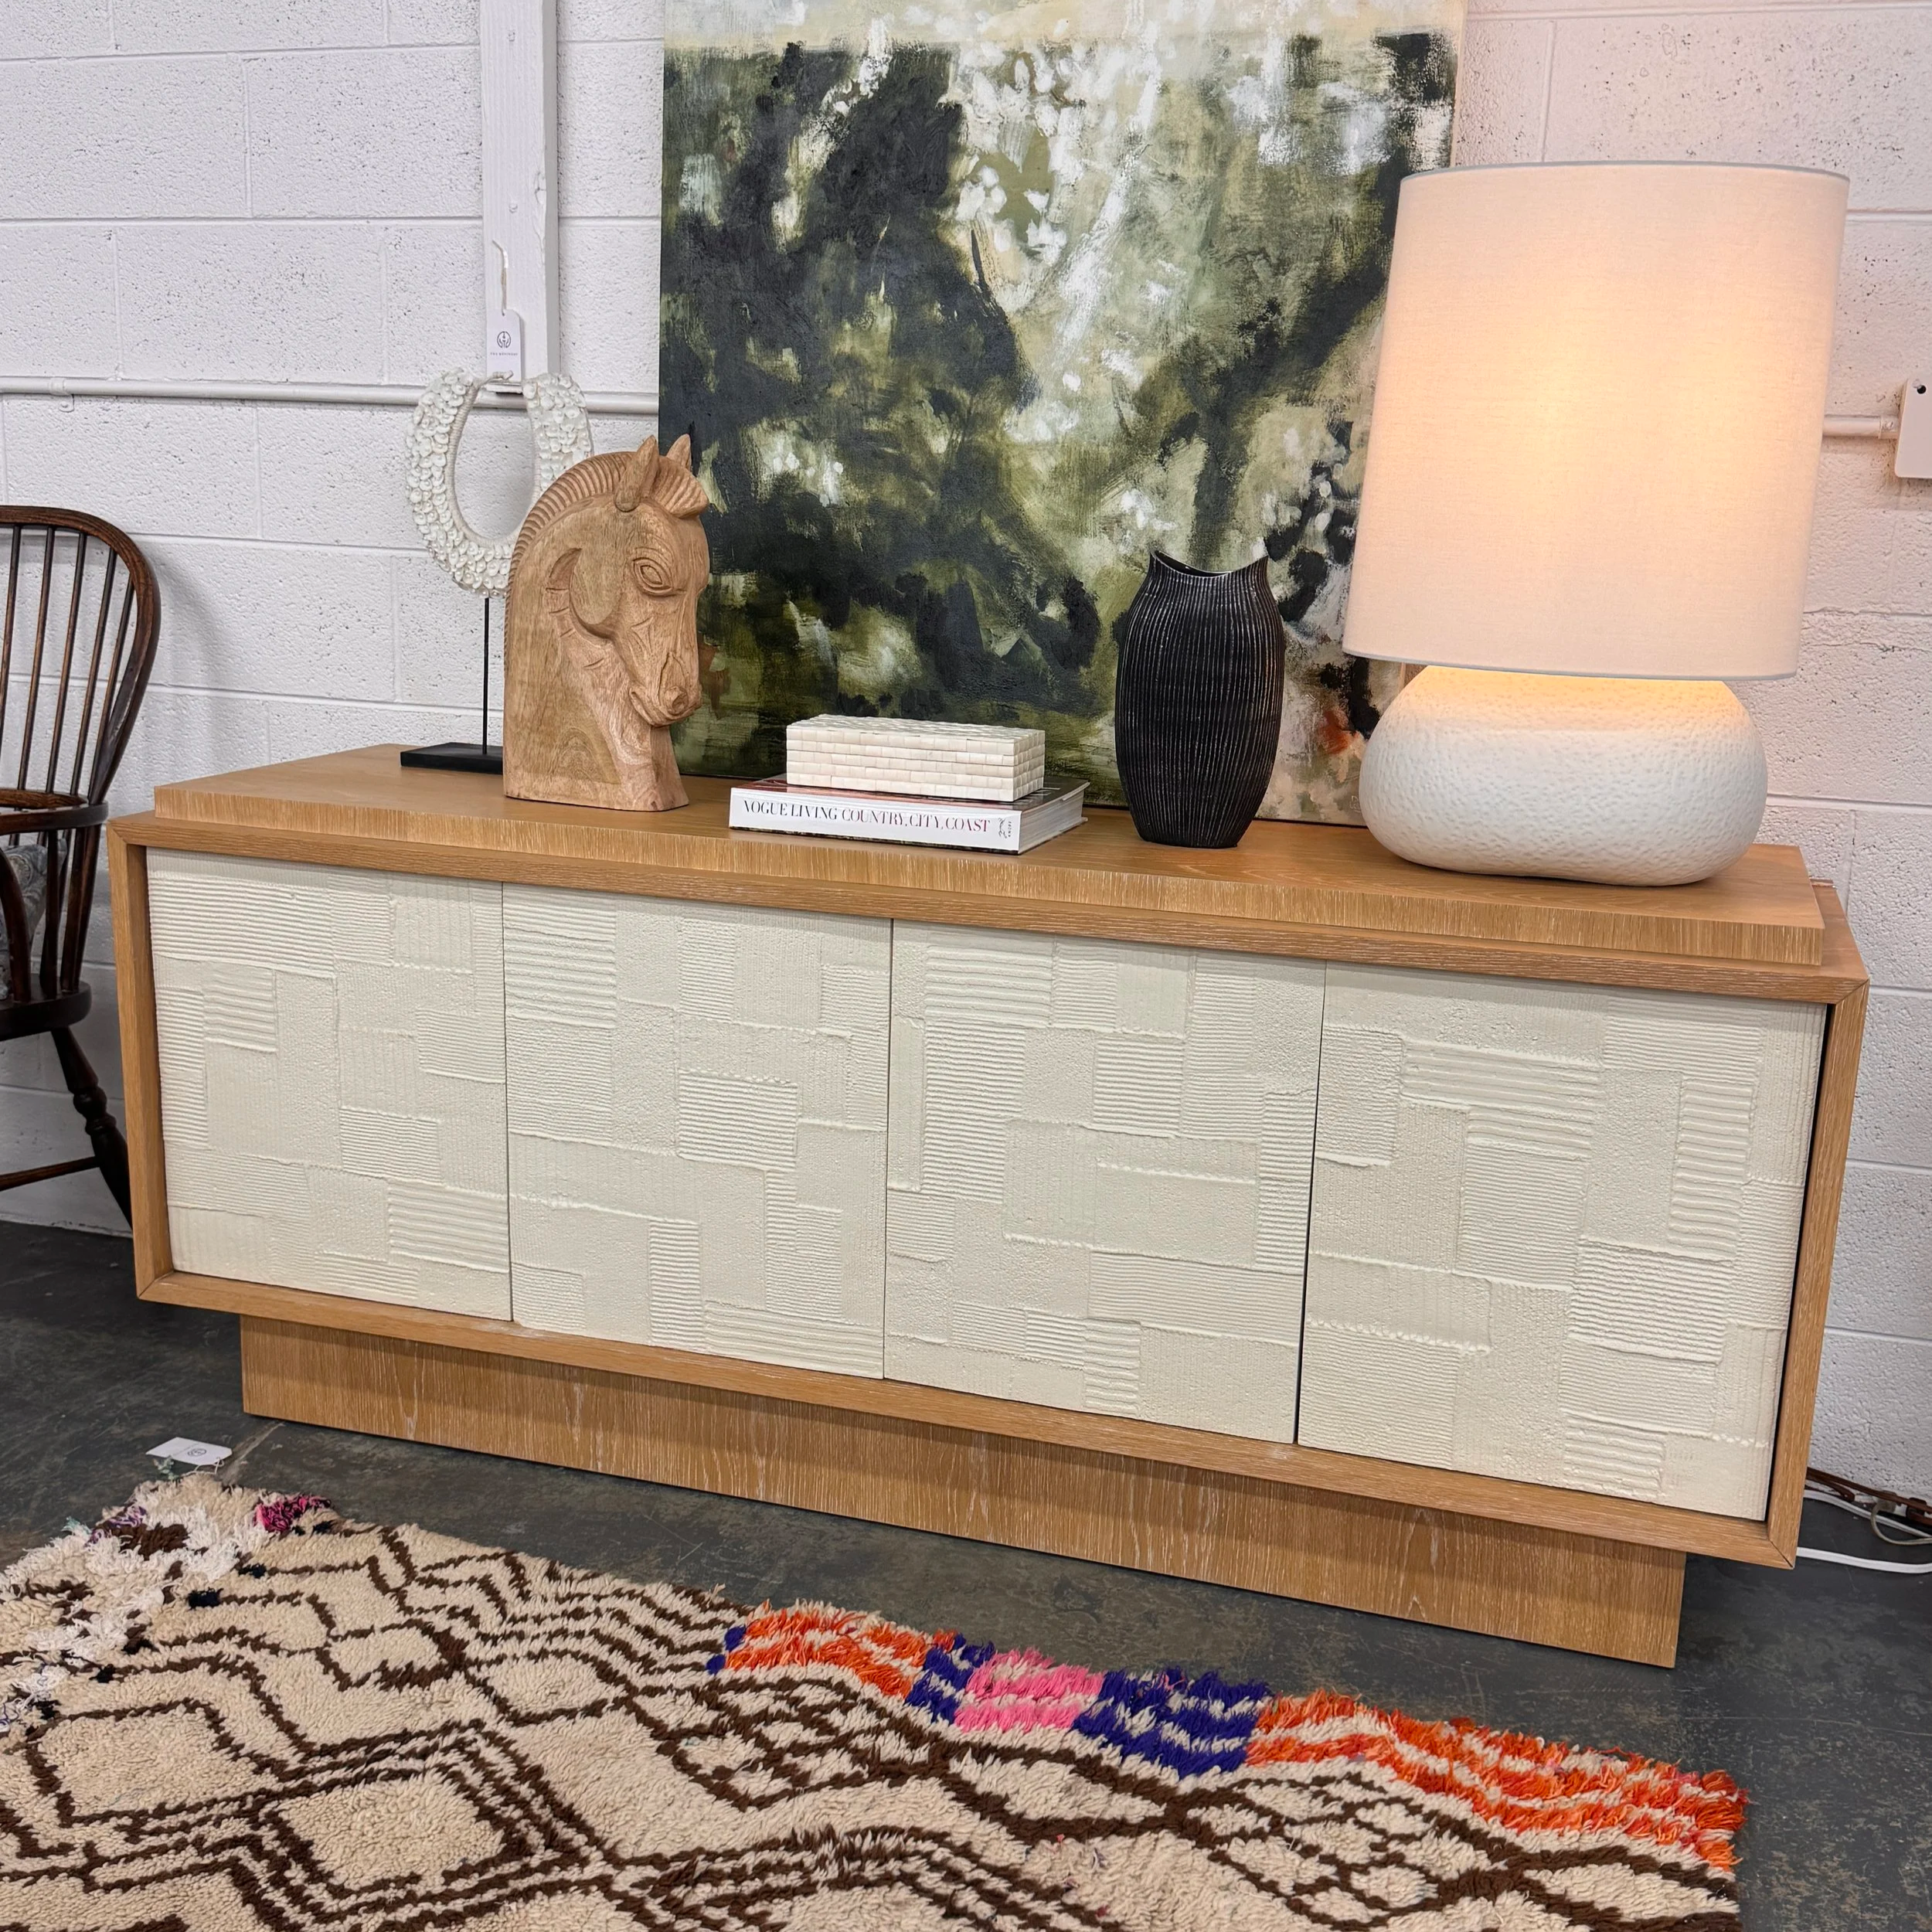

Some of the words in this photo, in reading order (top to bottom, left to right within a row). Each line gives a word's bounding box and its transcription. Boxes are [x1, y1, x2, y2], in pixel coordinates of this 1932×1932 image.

[743, 800, 787, 816] VOGUE
[791, 804, 838, 820] LIVING
[945, 817, 991, 832] COAST
